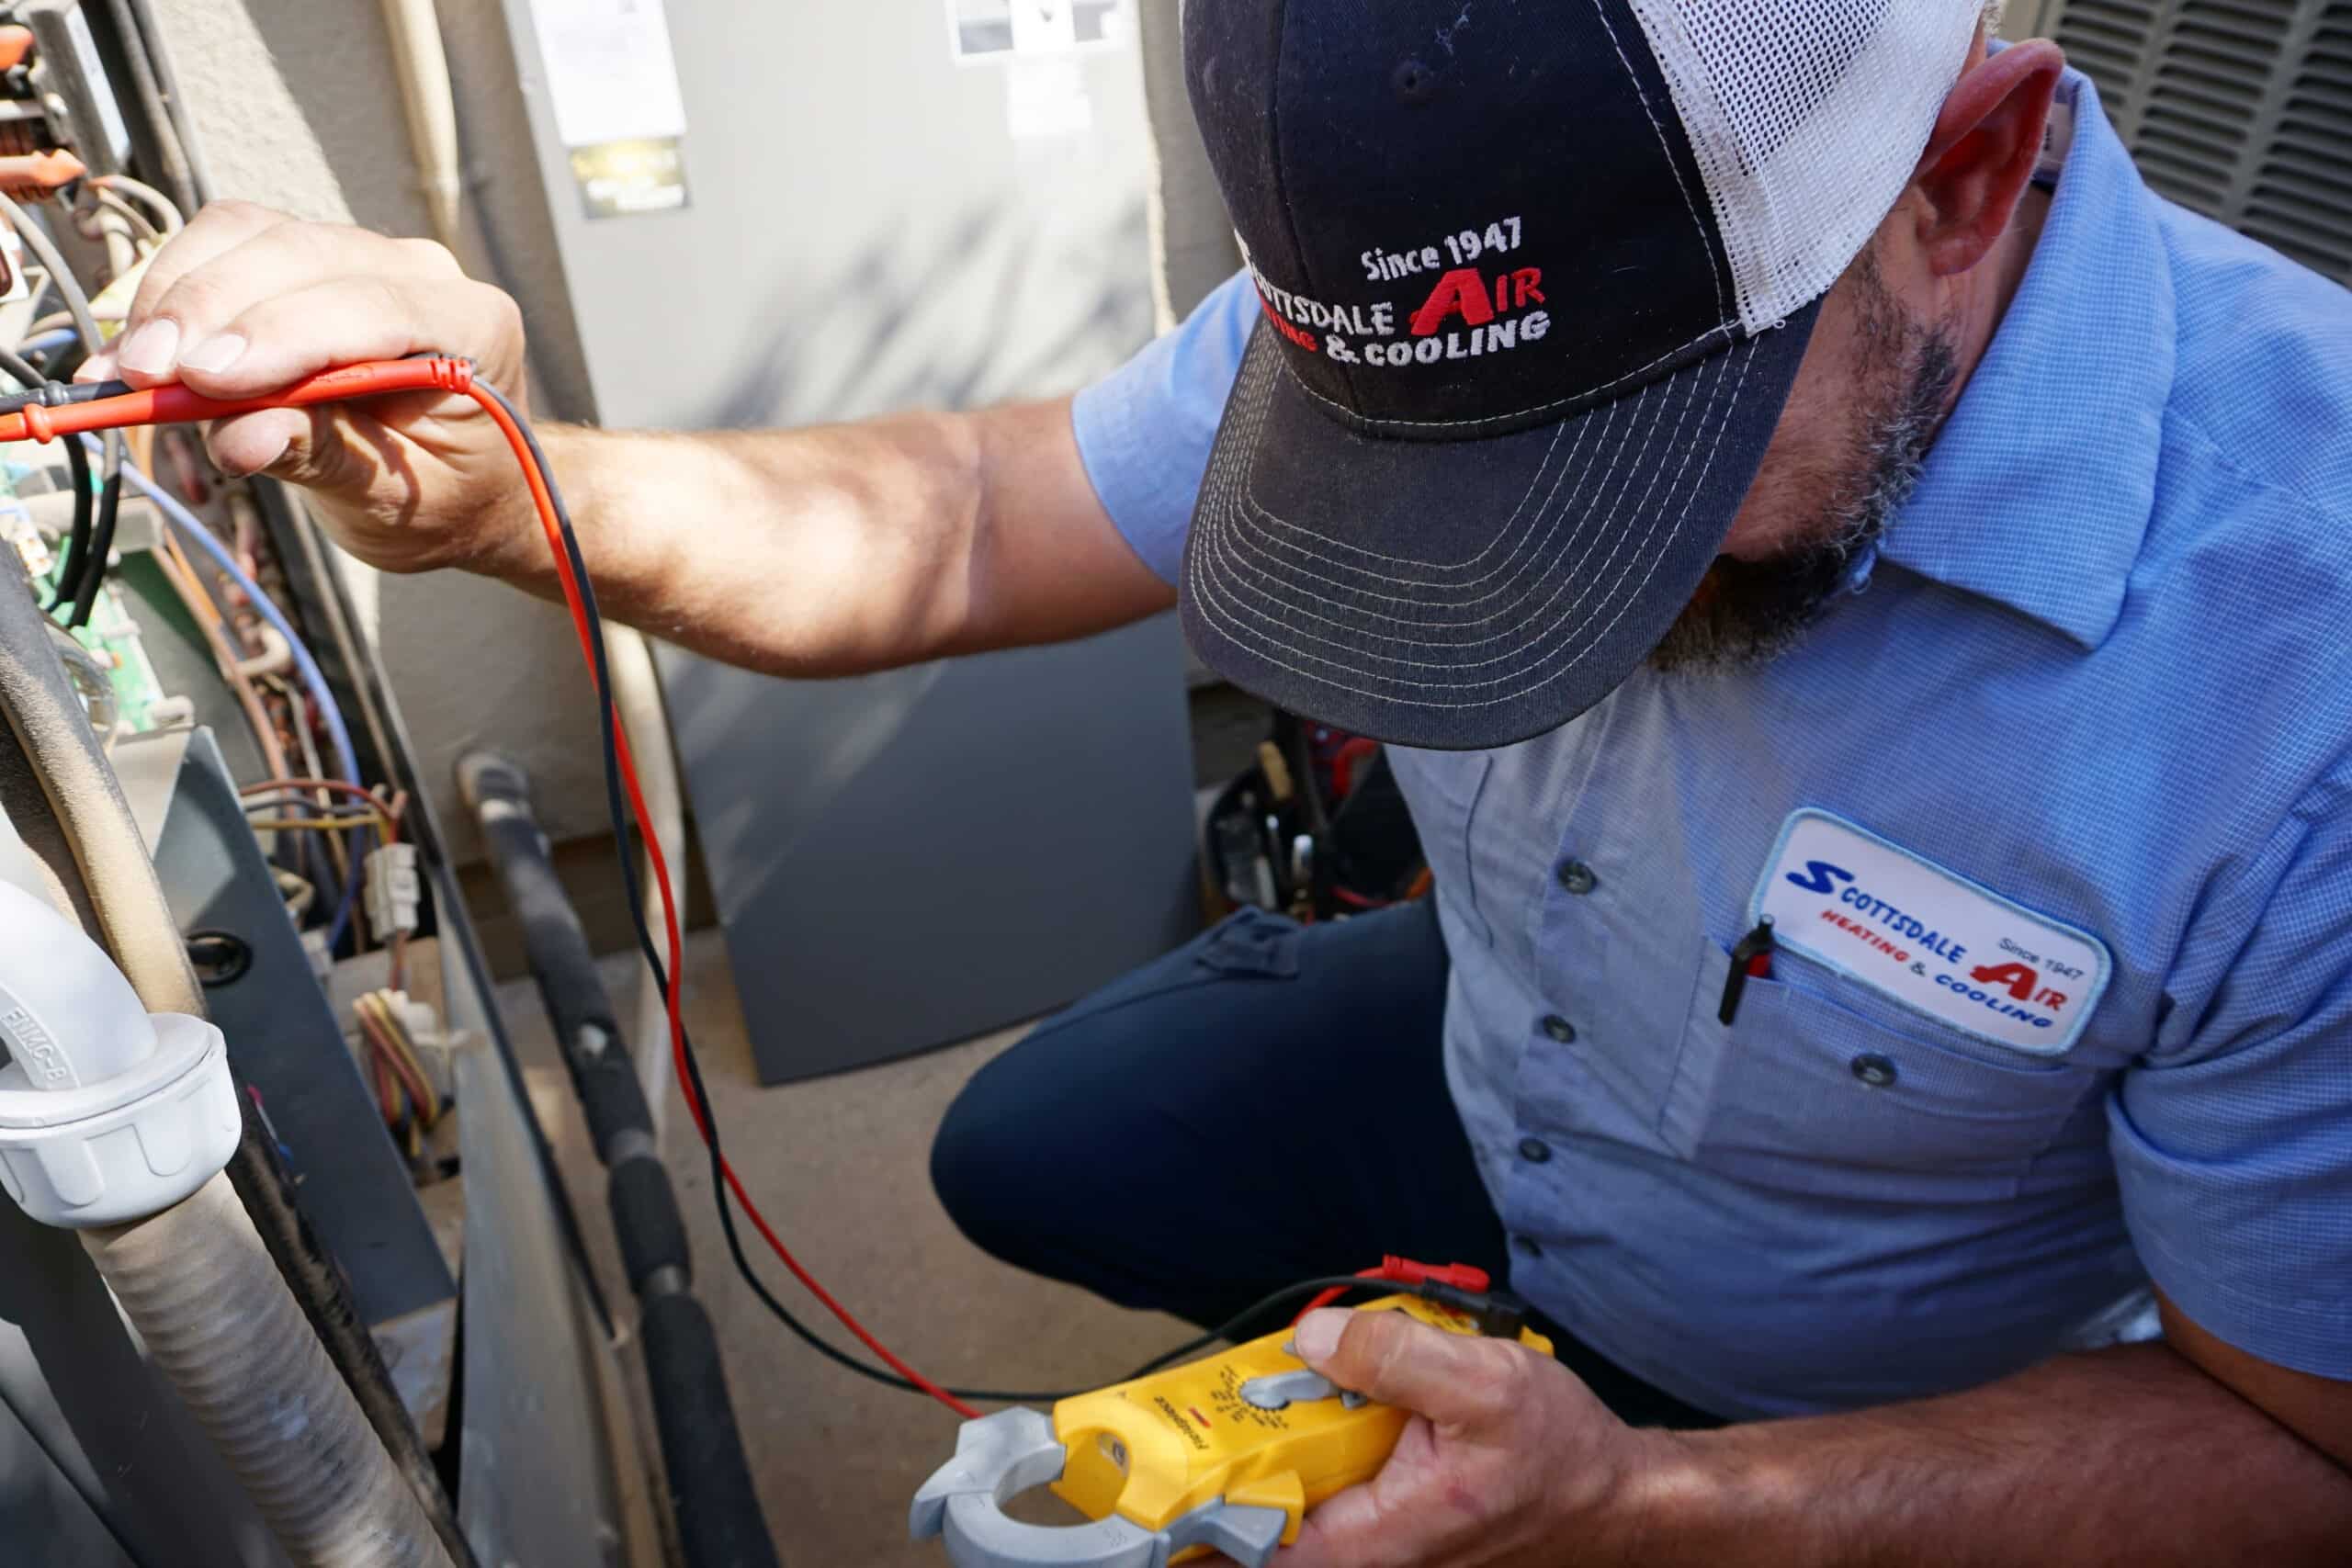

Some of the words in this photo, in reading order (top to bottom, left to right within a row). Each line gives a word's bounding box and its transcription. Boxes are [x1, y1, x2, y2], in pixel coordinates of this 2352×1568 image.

[1234, 228, 1393, 336] OTTSDALE
[1408, 267, 1546, 337] AIR
[1361, 245, 1441, 281] Since
[1443, 216, 1521, 265] 1947
[1325, 333, 1361, 366] &
[1364, 310, 1551, 367] COOLING
[1786, 860, 1968, 965] SCOTTSDALE
[1969, 962, 2069, 1011] AIR
[1821, 909, 1912, 964] HEATING
[1910, 961, 1927, 978] &
[1935, 974, 2054, 1030] COOLING
[1998, 938, 2041, 964] Since
[2045, 959, 2085, 982] 1947
